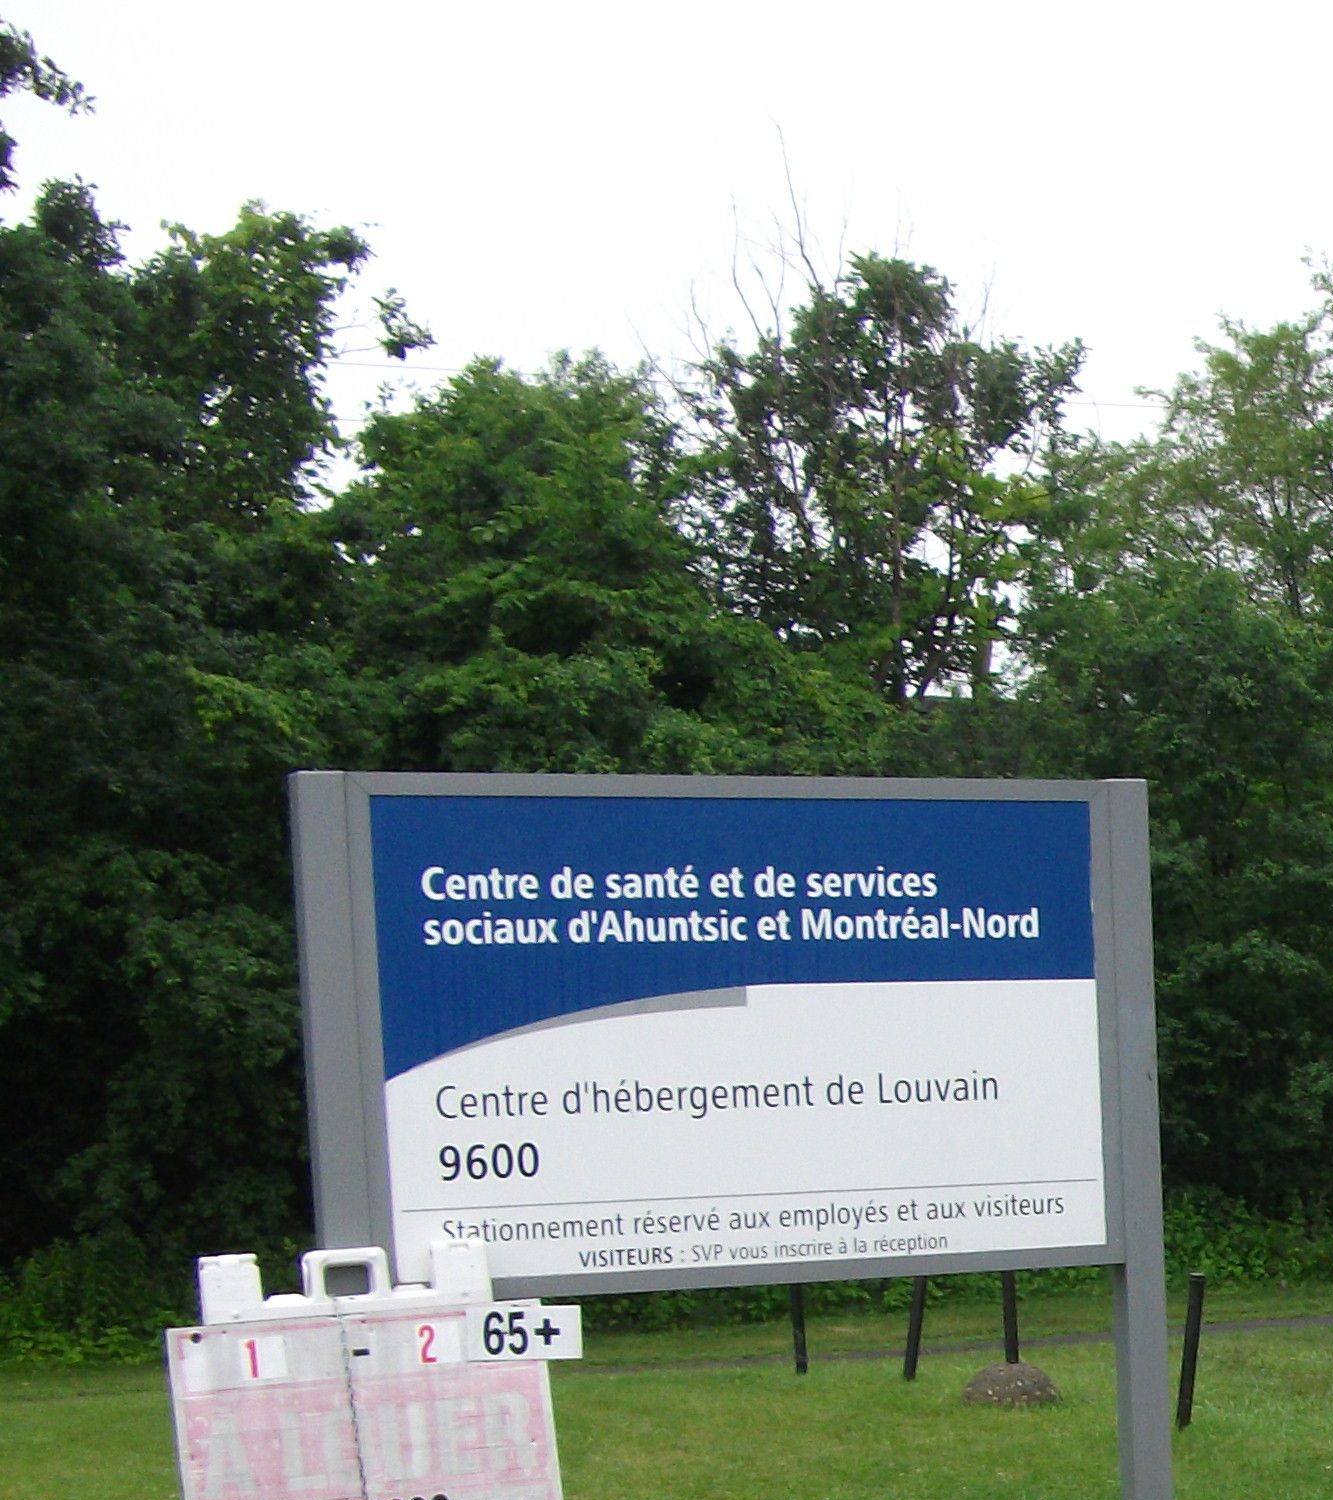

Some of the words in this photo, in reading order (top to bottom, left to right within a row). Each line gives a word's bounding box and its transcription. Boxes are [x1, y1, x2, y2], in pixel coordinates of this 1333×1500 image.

[421, 865, 540, 900] Centre
[550, 865, 595, 899] de
[605, 864, 700, 899] santé
[709, 866, 745, 898] et
[753, 865, 796, 898] de
[806, 865, 938, 898] services
[423, 911, 560, 945] sociaux
[567, 909, 749, 944] d'Ahuntsic
[756, 909, 792, 941] et
[800, 906, 1041, 941] Montréal-Nord
[435, 1084, 549, 1119] Centre
[562, 1078, 815, 1120] d'hébergement
[826, 1074, 865, 1105] de
[877, 1069, 999, 1104] Louvain
[439, 1142, 540, 1182] 9600
[442, 1213, 625, 1243] Stationnement
[633, 1206, 721, 1235] réservé
[729, 1210, 770, 1232] aux
[778, 1199, 889, 1232] employés
[897, 1199, 918, 1222] et
[926, 1200, 967, 1221] aux
[974, 1193, 1066, 1218] visiteurs
[578, 1245, 674, 1268] VISITEURS
[691, 1244, 724, 1263] SVP
[729, 1244, 769, 1261] vous
[774, 1239, 833, 1258] inscrire
[837, 1238, 849, 1255] à
[852, 1235, 868, 1254] la
[873, 1232, 949, 1256] réception
[244, 1338, 260, 1379] 1
[417, 1324, 438, 1364] 2
[482, 1310, 561, 1356] 65+
[279, 1391, 538, 1492] LOUER
